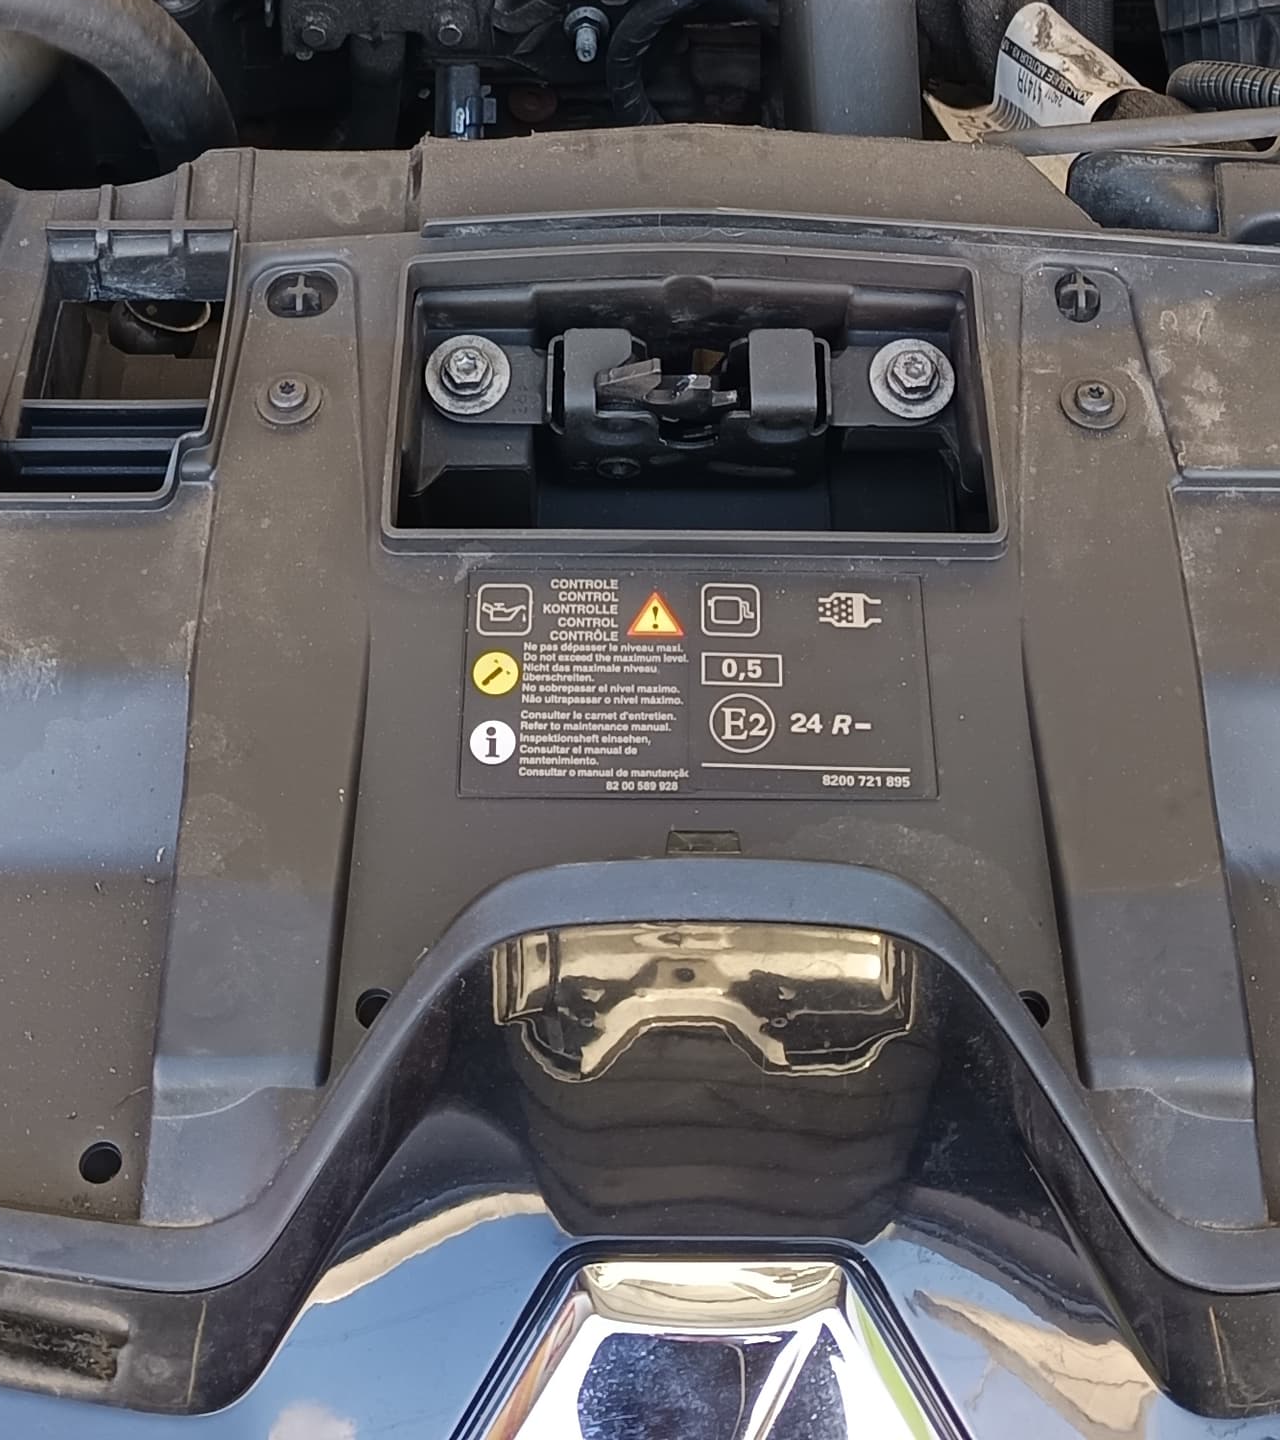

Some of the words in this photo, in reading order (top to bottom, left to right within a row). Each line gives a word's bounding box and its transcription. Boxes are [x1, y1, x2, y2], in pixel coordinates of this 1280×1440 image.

[550, 578, 619, 589] CONTROLE
[558, 591, 619, 602] CONTROL
[543, 603, 619, 614] KONTROLLE
[558, 617, 619, 628] CONTROL
[550, 629, 619, 641] CONTRÔLE
[523, 642, 538, 651] Ne
[540, 644, 558, 653] pas
[609, 643, 619, 651] le
[620, 643, 654, 652] niveau
[523, 653, 537, 662] Do
[540, 653, 556, 662] not
[558, 653, 593, 662] exceed
[595, 653, 611, 662] the
[613, 654, 662, 663] maximum
[522, 663, 550, 672] Nicht
[552, 664, 570, 672] das
[623, 664, 658, 673] niveau
[721, 658, 763, 681] 0,5
[521, 683, 537, 692] No
[598, 684, 608, 692] el
[520, 710, 570, 720] Consulter
[573, 711, 582, 720] le
[520, 721, 548, 731] Refer
[550, 722, 560, 731] to
[563, 722, 629, 731] maintenance
[721, 707, 769, 740] E2
[790, 713, 823, 734] 24
[520, 745, 570, 754] Consultar
[572, 746, 582, 754] el
[584, 746, 622, 754] manual
[624, 746, 637, 755] de
[519, 767, 567, 777] Consultar
[569, 769, 576, 777] o
[577, 768, 614, 777] manual
[616, 769, 629, 777] de
[606, 781, 619, 790] 82
[622, 781, 635, 790] 00
[822, 774, 855, 786] 8200
[858, 775, 882, 787] 721
[886, 776, 911, 788] 895
